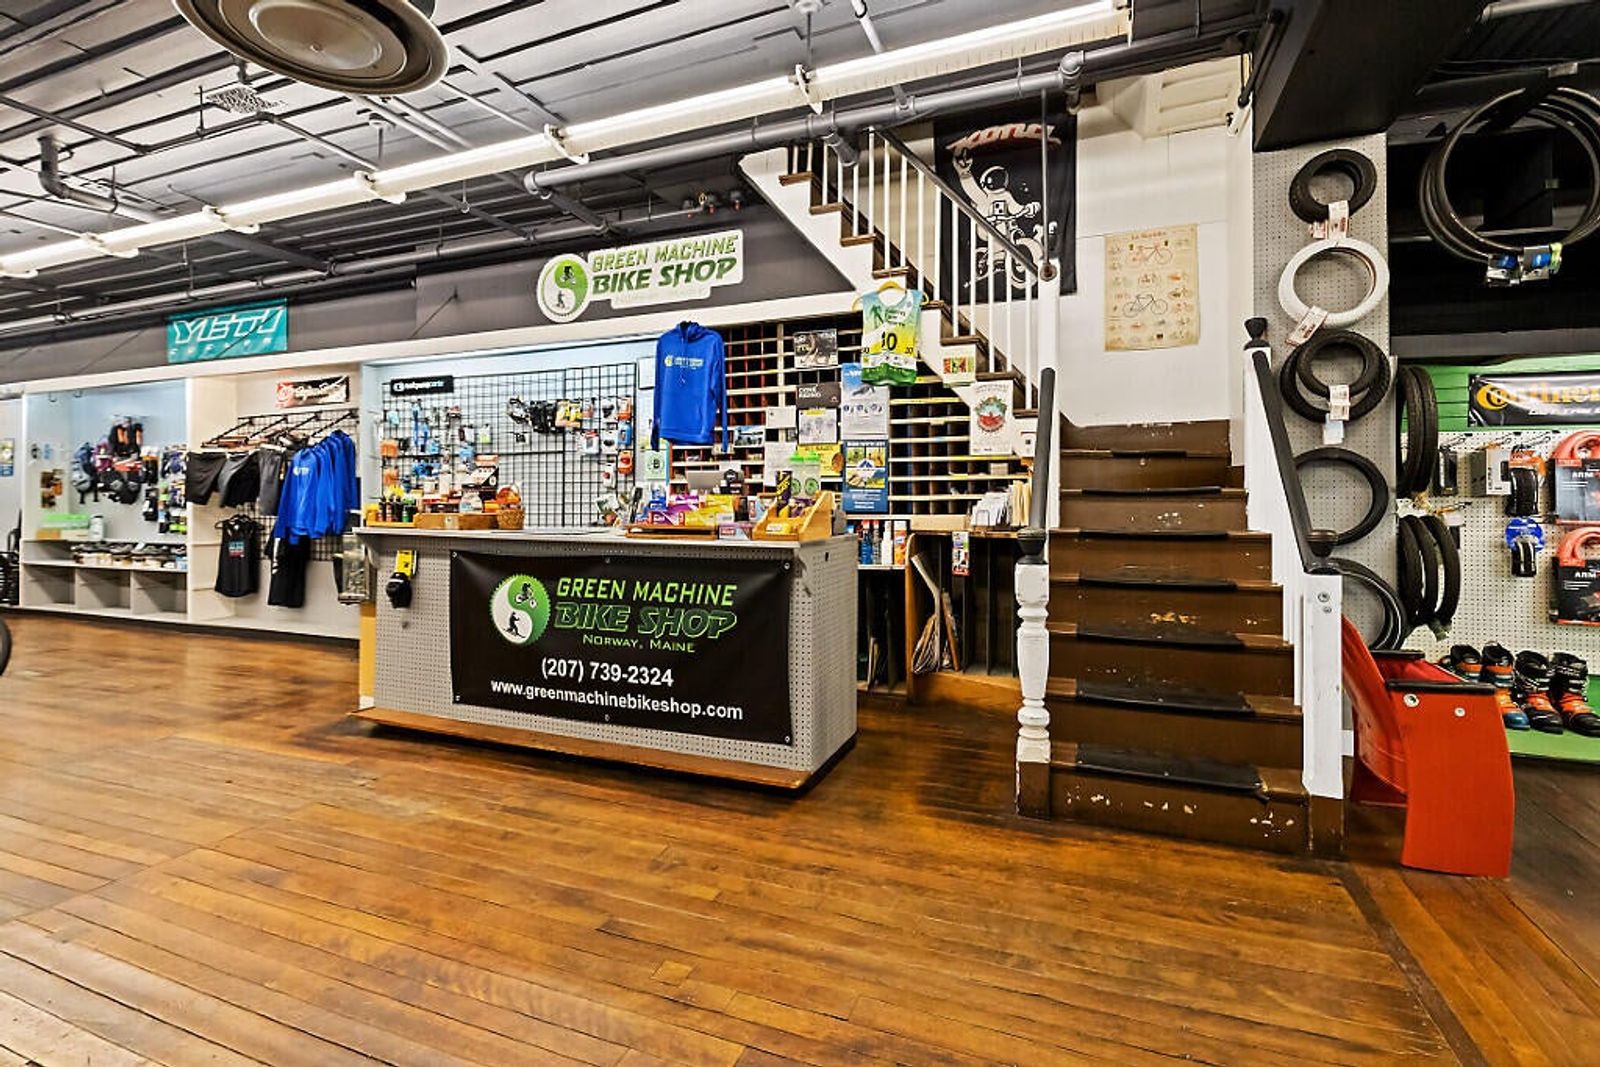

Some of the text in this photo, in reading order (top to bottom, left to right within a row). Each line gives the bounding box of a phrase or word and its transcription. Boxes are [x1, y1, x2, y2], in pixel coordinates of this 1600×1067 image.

[592, 234, 739, 273] GREEN MACHINE
[591, 256, 737, 295] BIKE SHOP
[556, 577, 737, 606] GREEN MACHINE
[554, 601, 737, 639] BIKE SHOP
[650, 639, 696, 653] MAINE
[541, 657, 674, 688] (207) 739-2324
[490, 679, 743, 720] www.greenmachinebikeshop.com
